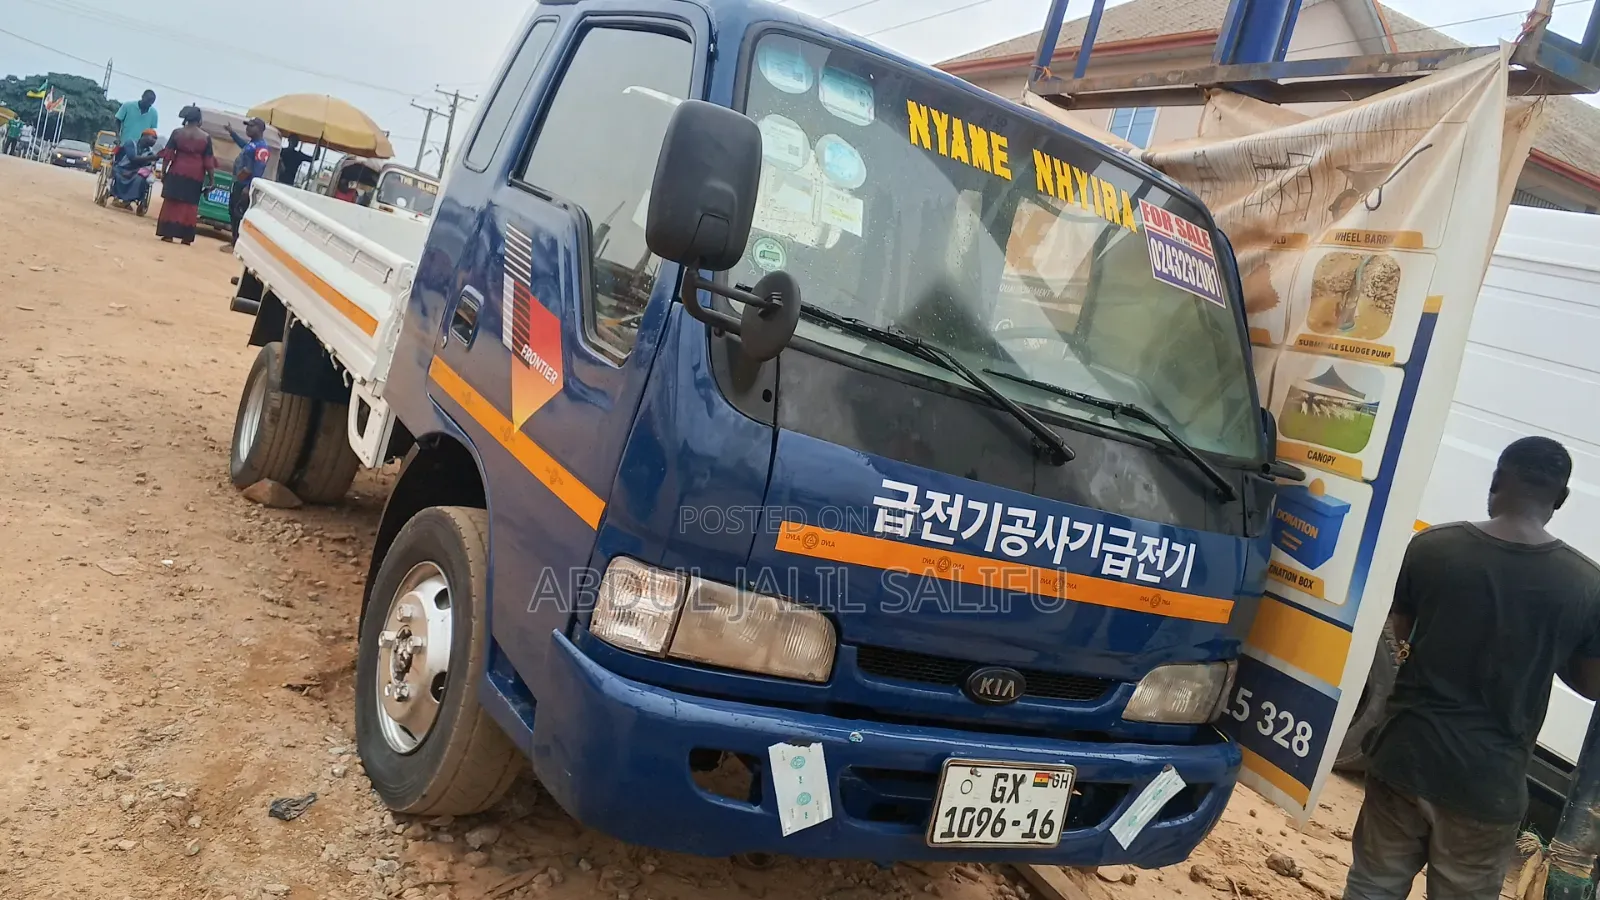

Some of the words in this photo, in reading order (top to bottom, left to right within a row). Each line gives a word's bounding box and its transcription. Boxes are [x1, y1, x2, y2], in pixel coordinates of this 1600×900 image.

[906, 98, 1012, 181] NYAME
[1032, 148, 1138, 234] NHYIRA
[1140, 201, 1174, 234] FOR
[1174, 217, 1212, 252] SALE
[1335, 231, 1361, 243] WHEEL
[1150, 237, 1221, 298] 0243232081
[520, 344, 558, 385] FRONTIER
[1340, 344, 1370, 356] SLUDGE
[1371, 349, 1391, 360] PUMP
[1307, 450, 1336, 466] CANOPY
[873, 478, 1197, 589] 급전기공사기급전기
[1276, 508, 1319, 539] DONATION
[785, 532, 801, 543] DVLA
[820, 539, 836, 549] DVLA
[922, 557, 935, 566] DVLA
[1267, 564, 1298, 584] ONATION
[1298, 576, 1314, 590] BOX
[979, 677, 1016, 698] KIA
[1256, 701, 1313, 758] 328
[990, 772, 1027, 804] GX
[939, 806, 1056, 840] 1096-16
